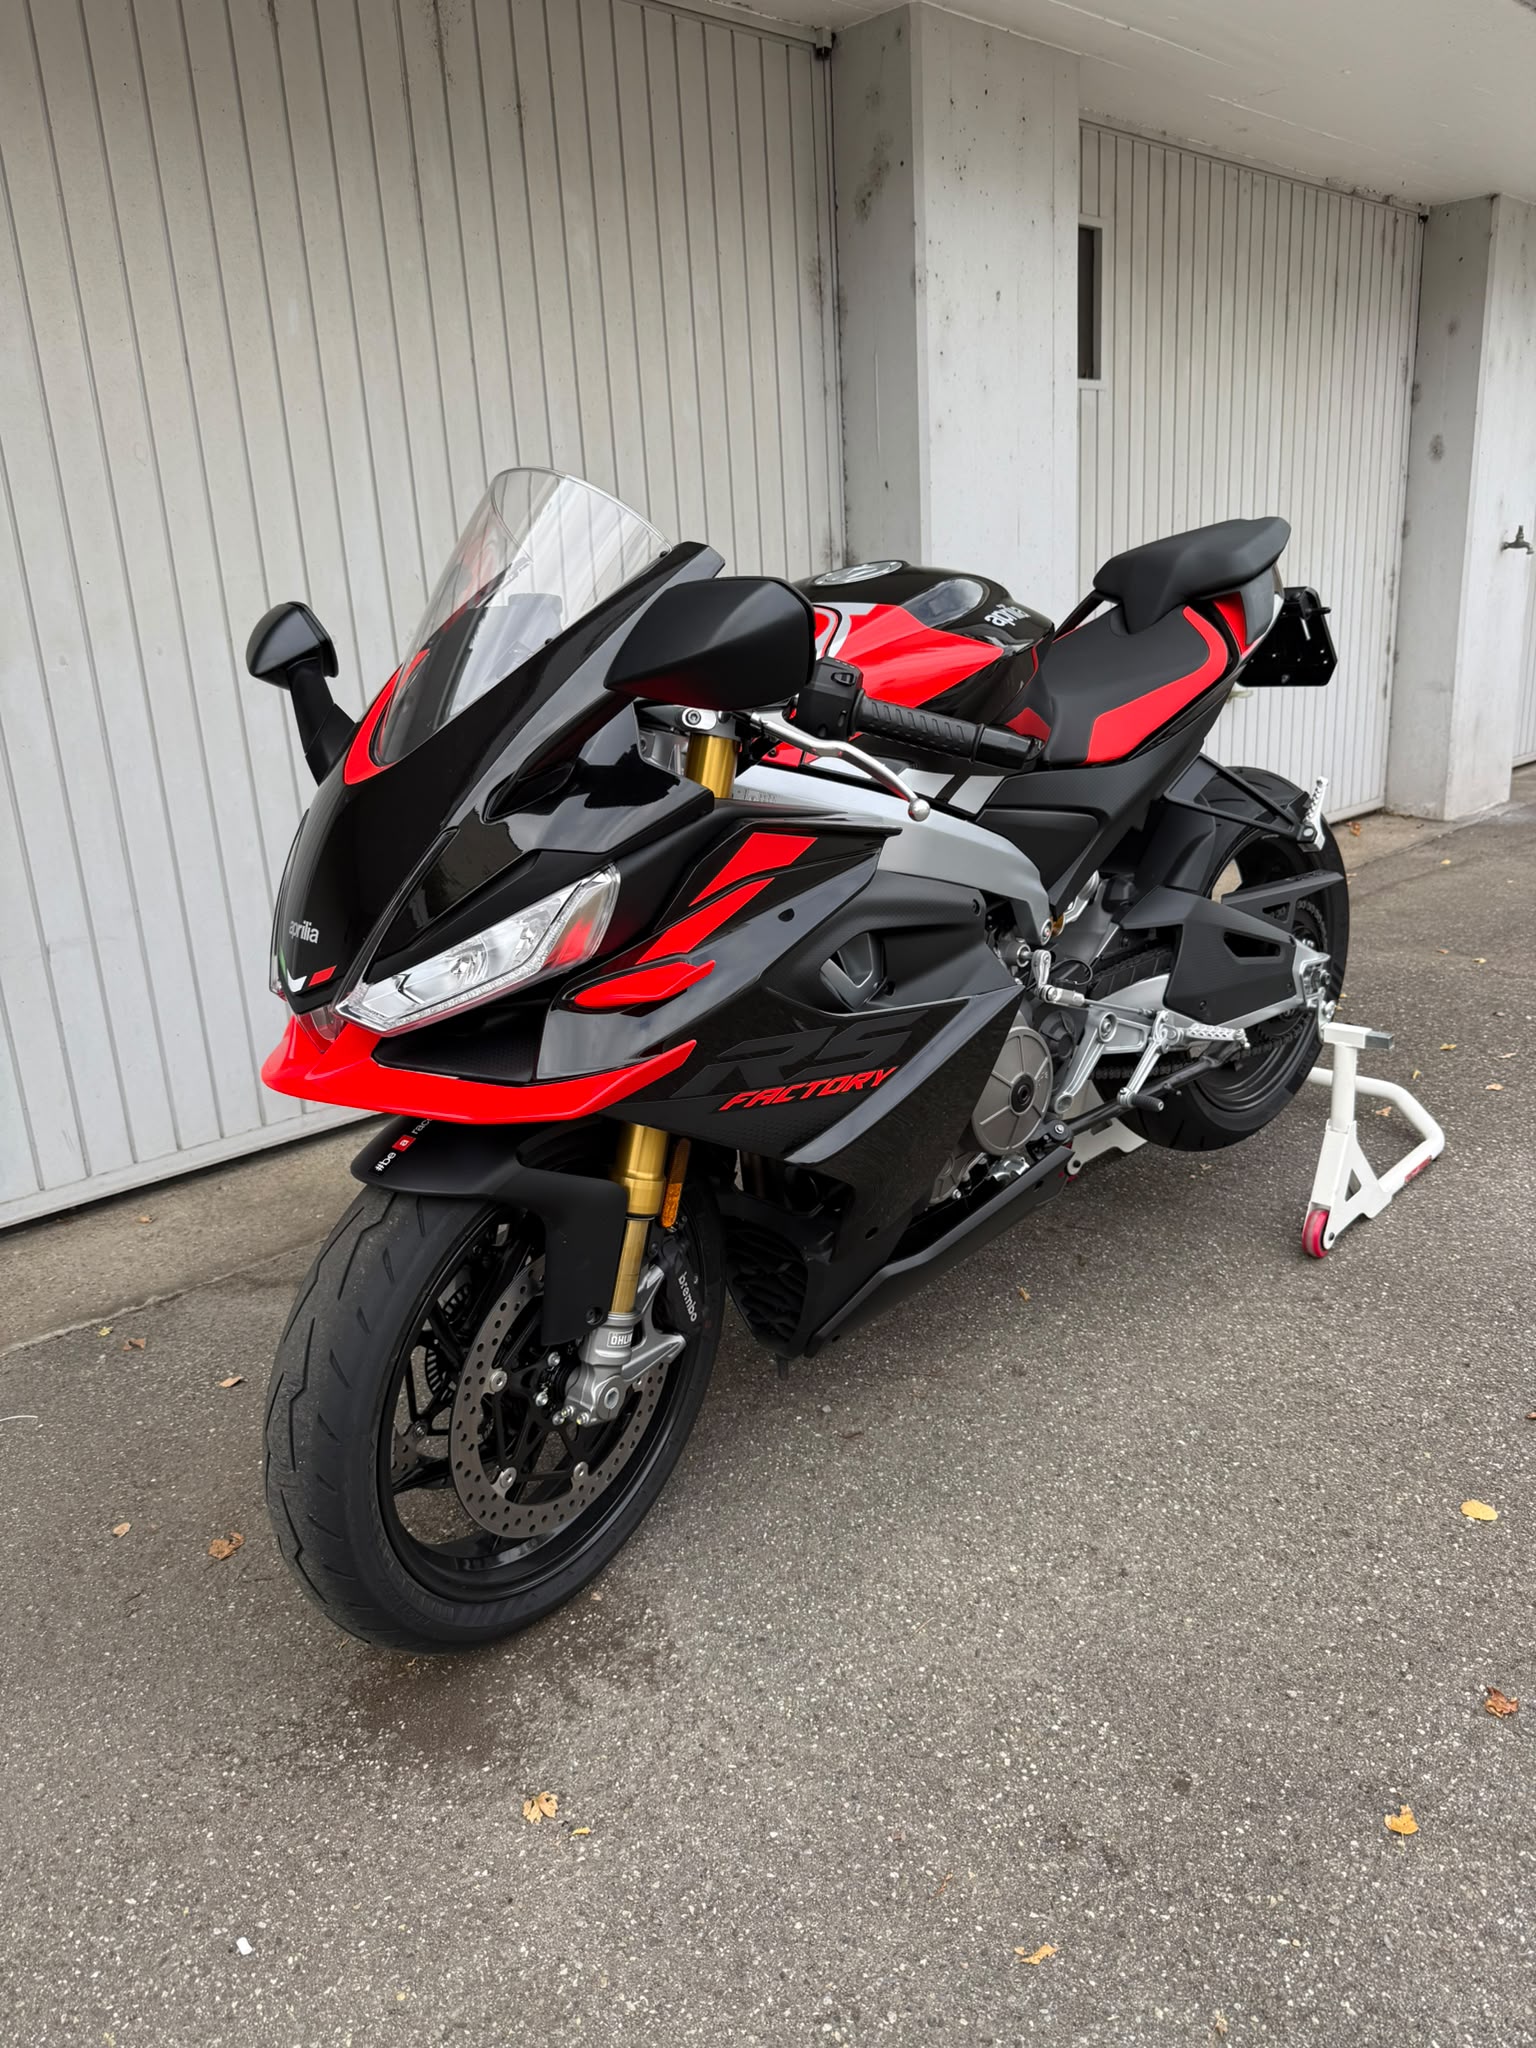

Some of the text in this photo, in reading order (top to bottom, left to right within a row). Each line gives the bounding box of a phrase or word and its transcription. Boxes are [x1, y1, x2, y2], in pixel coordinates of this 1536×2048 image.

[289, 920, 319, 944] aprilia
[671, 1010, 928, 1098] RS
[719, 1066, 898, 1111] FACTORY
[375, 1152, 396, 1171] #be
[678, 1271, 697, 1322] brembo
